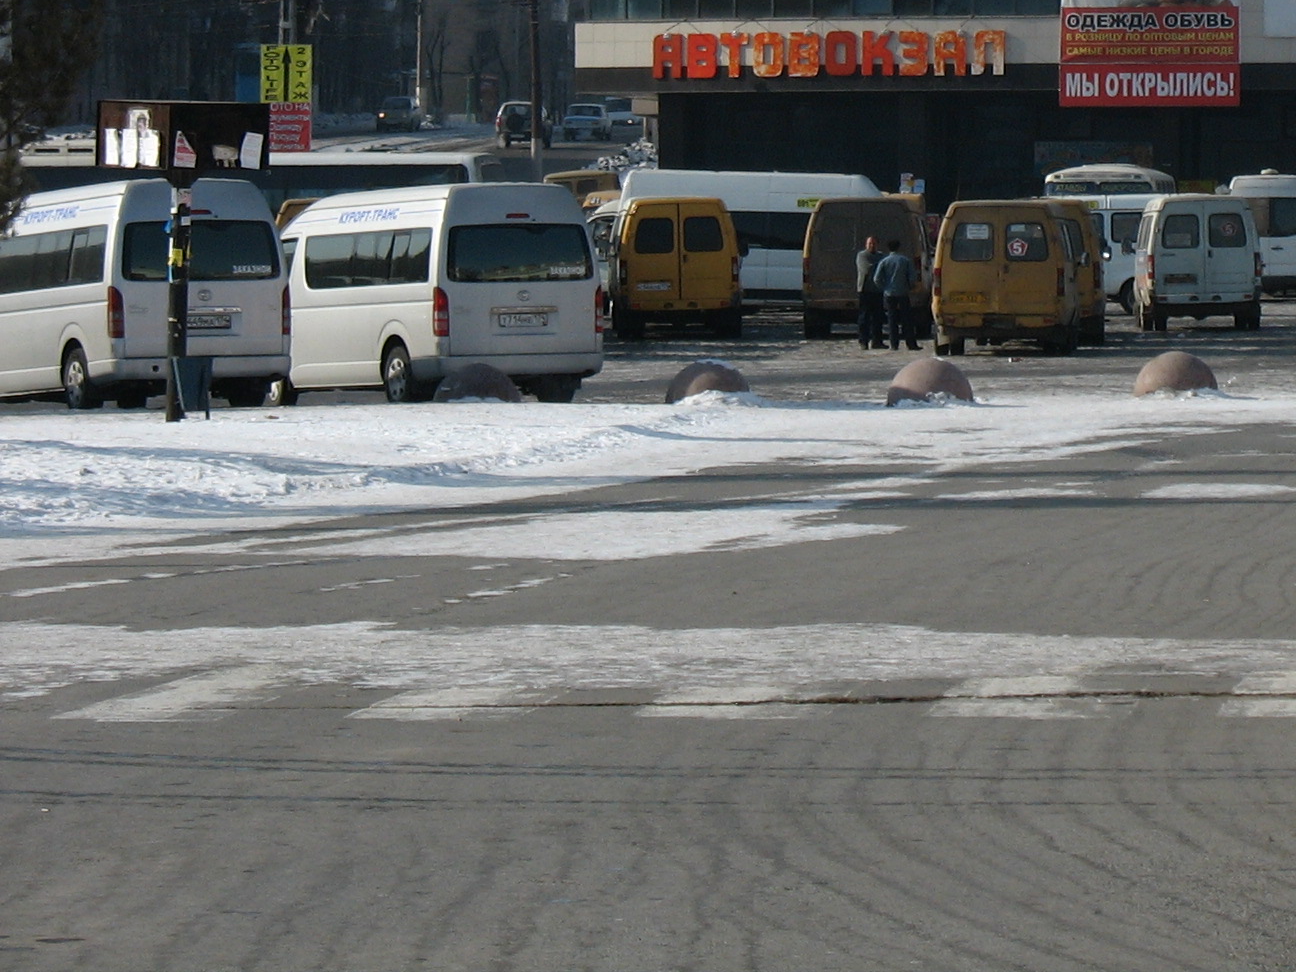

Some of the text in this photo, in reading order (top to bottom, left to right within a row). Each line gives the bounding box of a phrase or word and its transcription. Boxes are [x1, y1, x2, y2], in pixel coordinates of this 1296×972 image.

[1066, 13, 1234, 31] ОДЕЖДА ОБУВЬ
[1075, 32, 1123, 43] РОЗНИЦУ
[1125, 32, 1140, 41] ПО
[1143, 32, 1196, 41] ОПТОВЫМ
[1198, 32, 1234, 42] ЦЕНАМ
[264, 45, 280, 71] FOTO
[297, 47, 306, 55] 2
[652, 30, 1006, 80] АВТОВОКЗАЛ
[1066, 46, 1103, 55] САМЫЕ
[1106, 46, 1148, 55] НИЗКИЕ
[1150, 46, 1182, 56] ЦЕНЫ
[1193, 46, 1234, 56] ГОРОДЕ
[265, 75, 279, 101] LIFE
[292, 60, 309, 99] ЭТАЖ
[1065, 72, 1235, 98] МЫ ОТКРЫЛИСЬ!
[1012, 243, 1023, 255] 5
